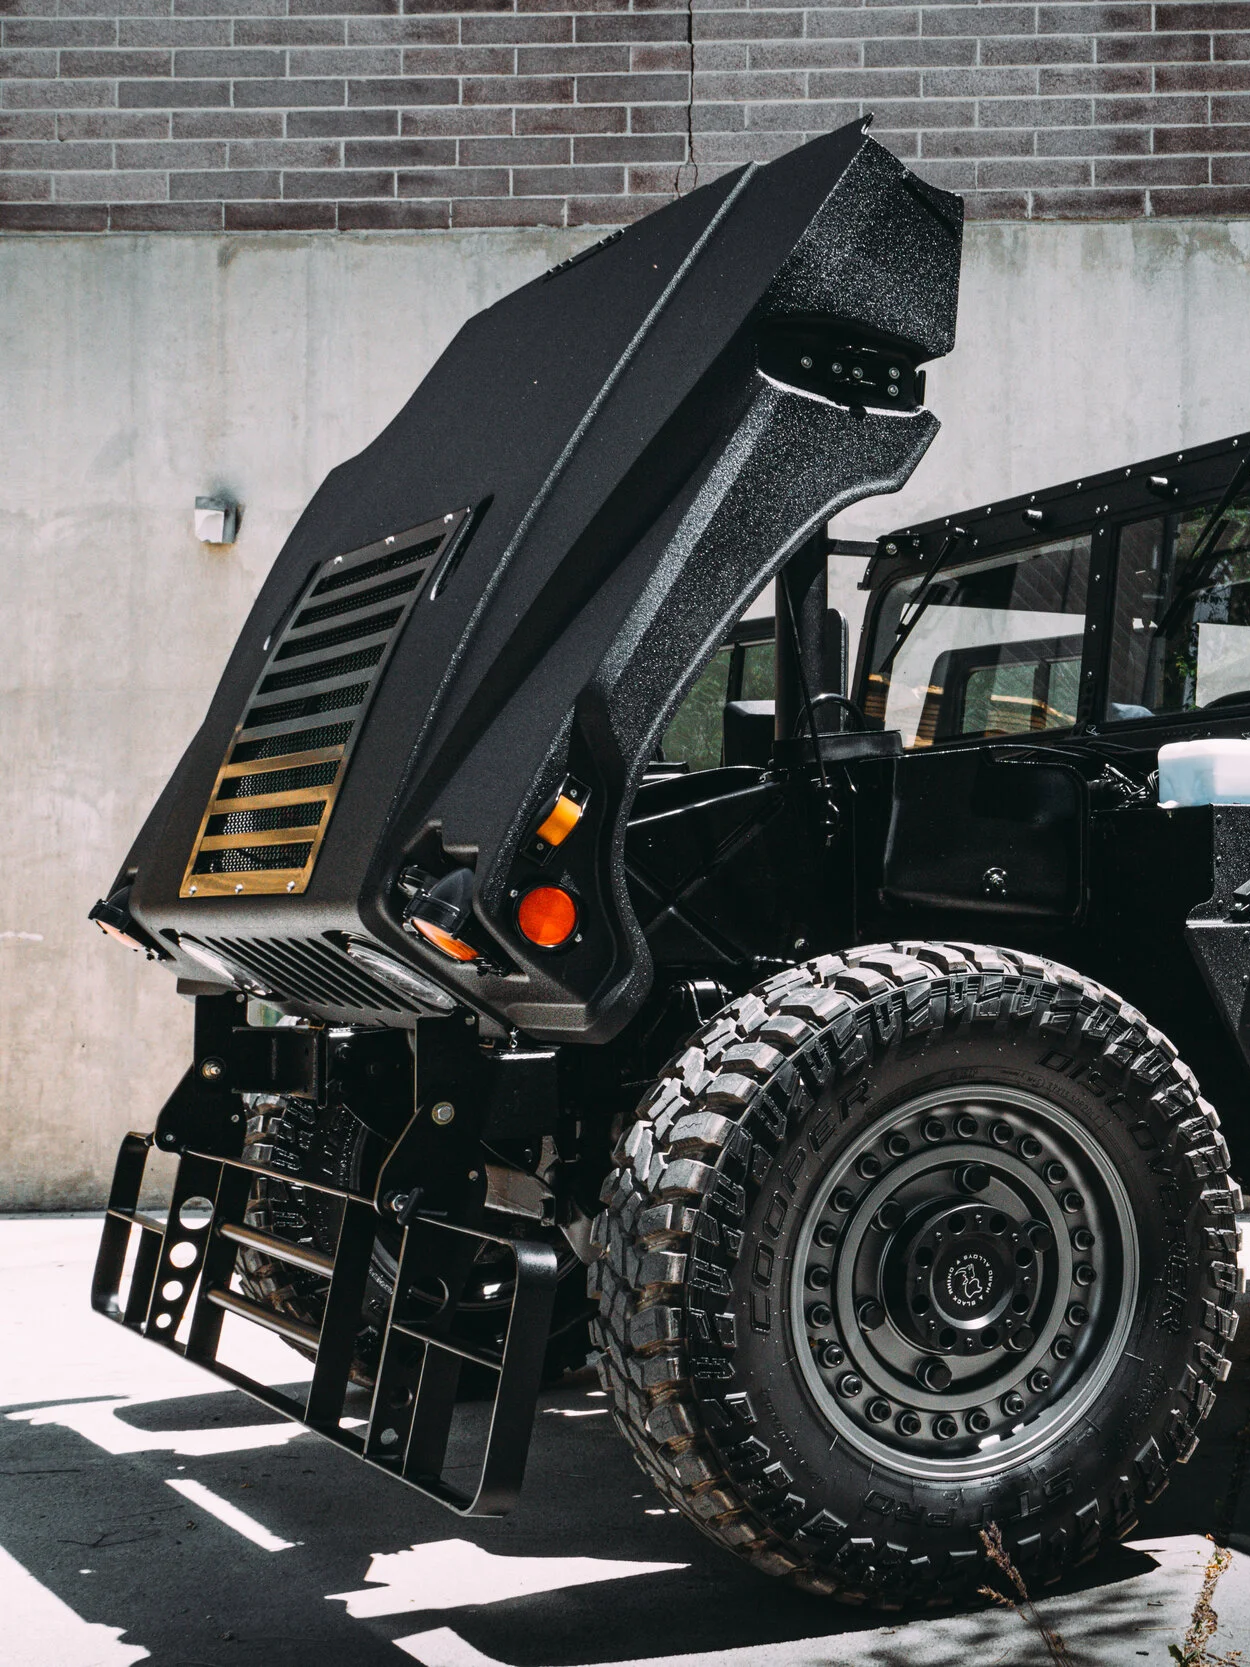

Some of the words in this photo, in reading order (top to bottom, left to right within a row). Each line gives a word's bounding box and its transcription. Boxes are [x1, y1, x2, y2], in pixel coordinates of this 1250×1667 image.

[751, 1075, 871, 1333] COOPER
[1037, 1050, 1188, 1334] DISCOVERER
[963, 1253, 990, 1267] ALLOYS
[946, 1266, 955, 1295] RHINO
[985, 1269, 994, 1294] HARD
[952, 1295, 977, 1307] BLACK
[863, 1489, 957, 1528] PRO
